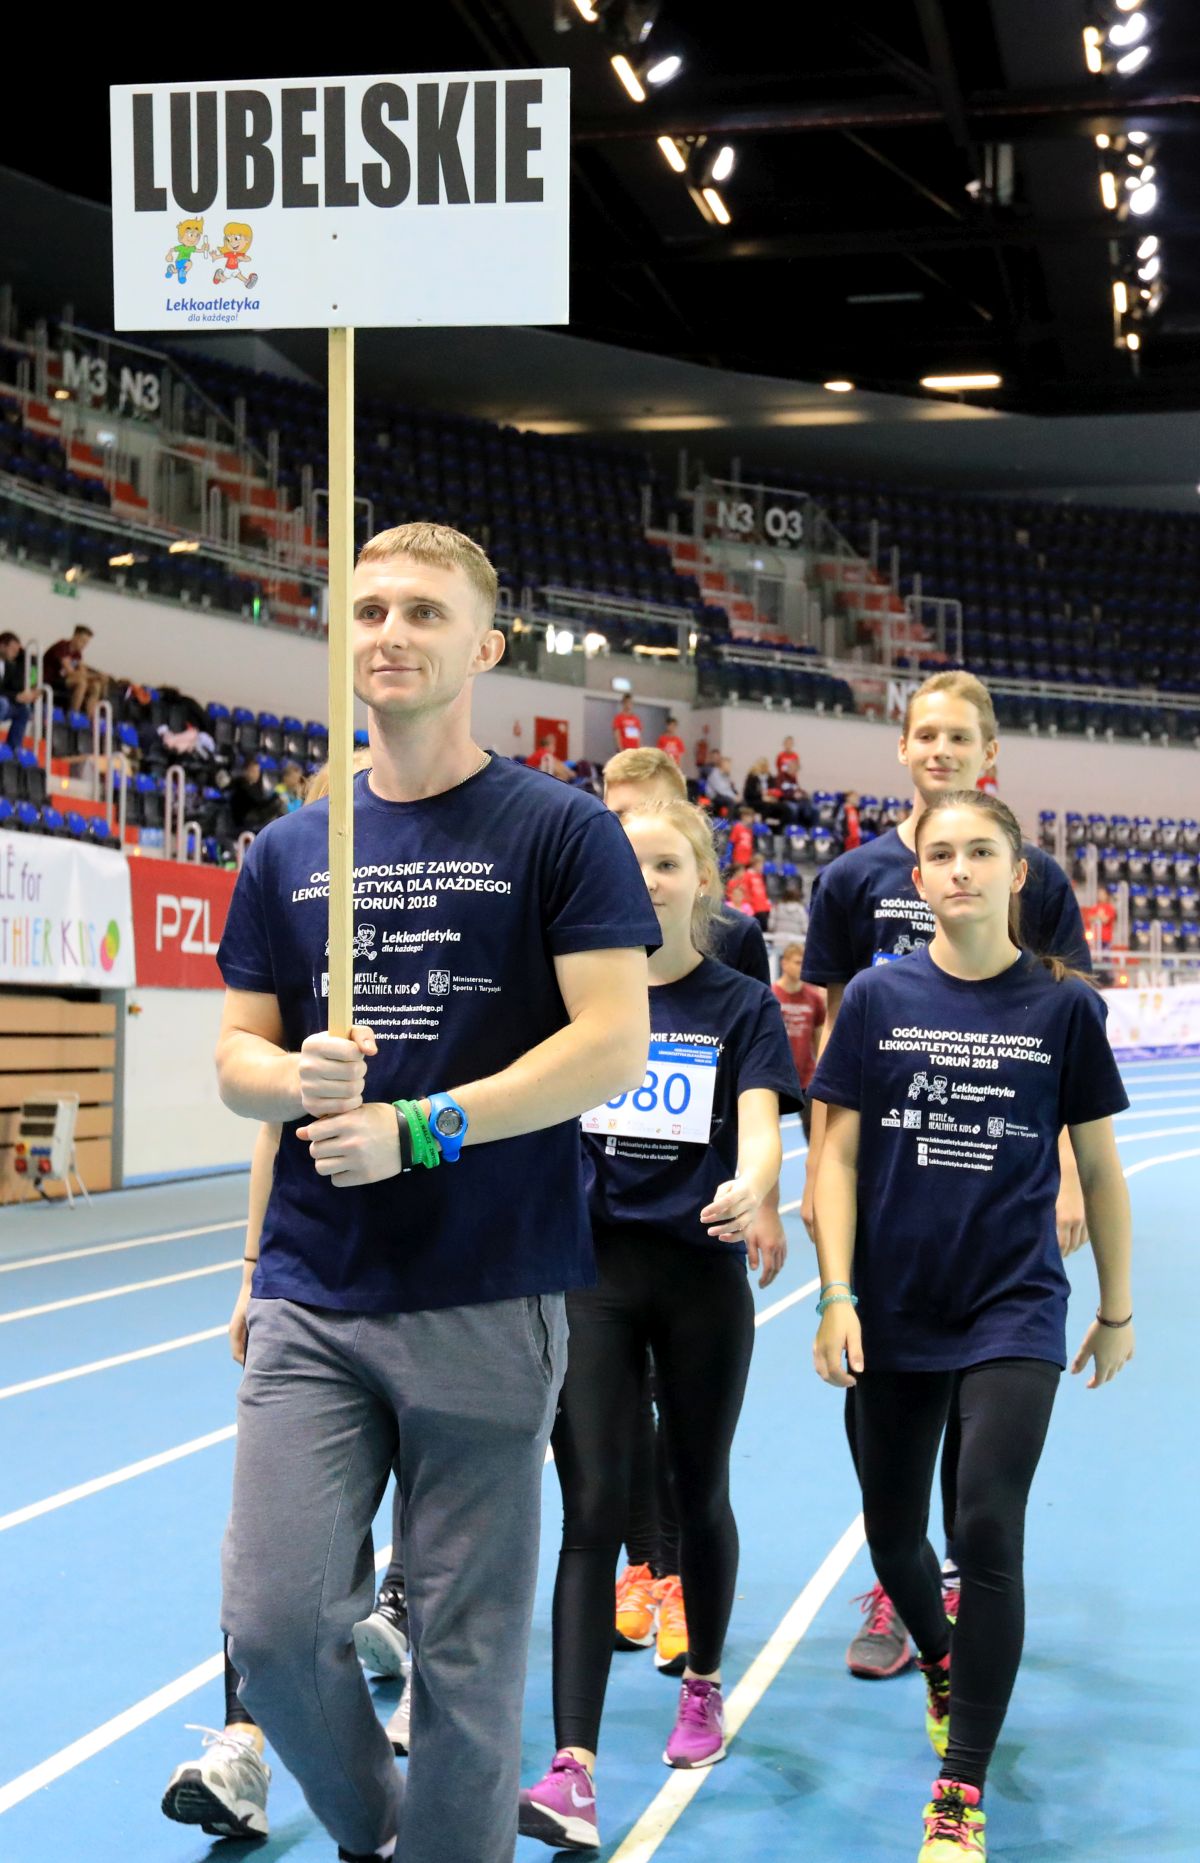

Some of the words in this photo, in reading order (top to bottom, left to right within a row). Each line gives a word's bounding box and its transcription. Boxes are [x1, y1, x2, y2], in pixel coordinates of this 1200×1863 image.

[132, 79, 544, 213] LUBELSKIE
[166, 297, 260, 313] Lekkoatletyka
[187, 314, 201, 322] dla
[202, 313, 239, 323] każdego!
[62, 351, 108, 396] M3
[119, 366, 161, 411] N3
[717, 500, 754, 533] N3
[310, 861, 425, 884] OGNOPOLSKIE
[426, 861, 494, 876] ZAWODY
[21, 861, 42, 901] for
[292, 881, 403, 902] LEKKOLETYKA
[407, 878, 433, 893] DLA
[436, 876, 512, 895] KAŻDEGO!
[353, 895, 404, 910] TORUŃ
[407, 895, 437, 910] 2018
[382, 929, 461, 944] Lekkoatletyka
[382, 944, 394, 953] dla
[379, 975, 389, 983] for
[452, 976, 493, 984] Ministerstwo
[353, 984, 392, 995] HEALTHIER
[394, 984, 411, 995] KIDS
[452, 984, 473, 992] Sportu
[355, 1018, 400, 1027] Lekkoatletyka
[669, 1033, 719, 1046] ZAWODY
[892, 1026, 989, 1044] OGÓLNOPOLSKIE
[990, 1034, 1043, 1049] ZAWODY
[879, 1040, 970, 1056] LEKKOATLETYKA
[972, 1046, 996, 1057] DLA
[997, 1046, 1052, 1065] KAŻDEGO!
[929, 1054, 970, 1068] TORUŃ
[972, 1059, 999, 1070] 2018
[951, 1082, 1016, 1098] Lekkoatletyka
